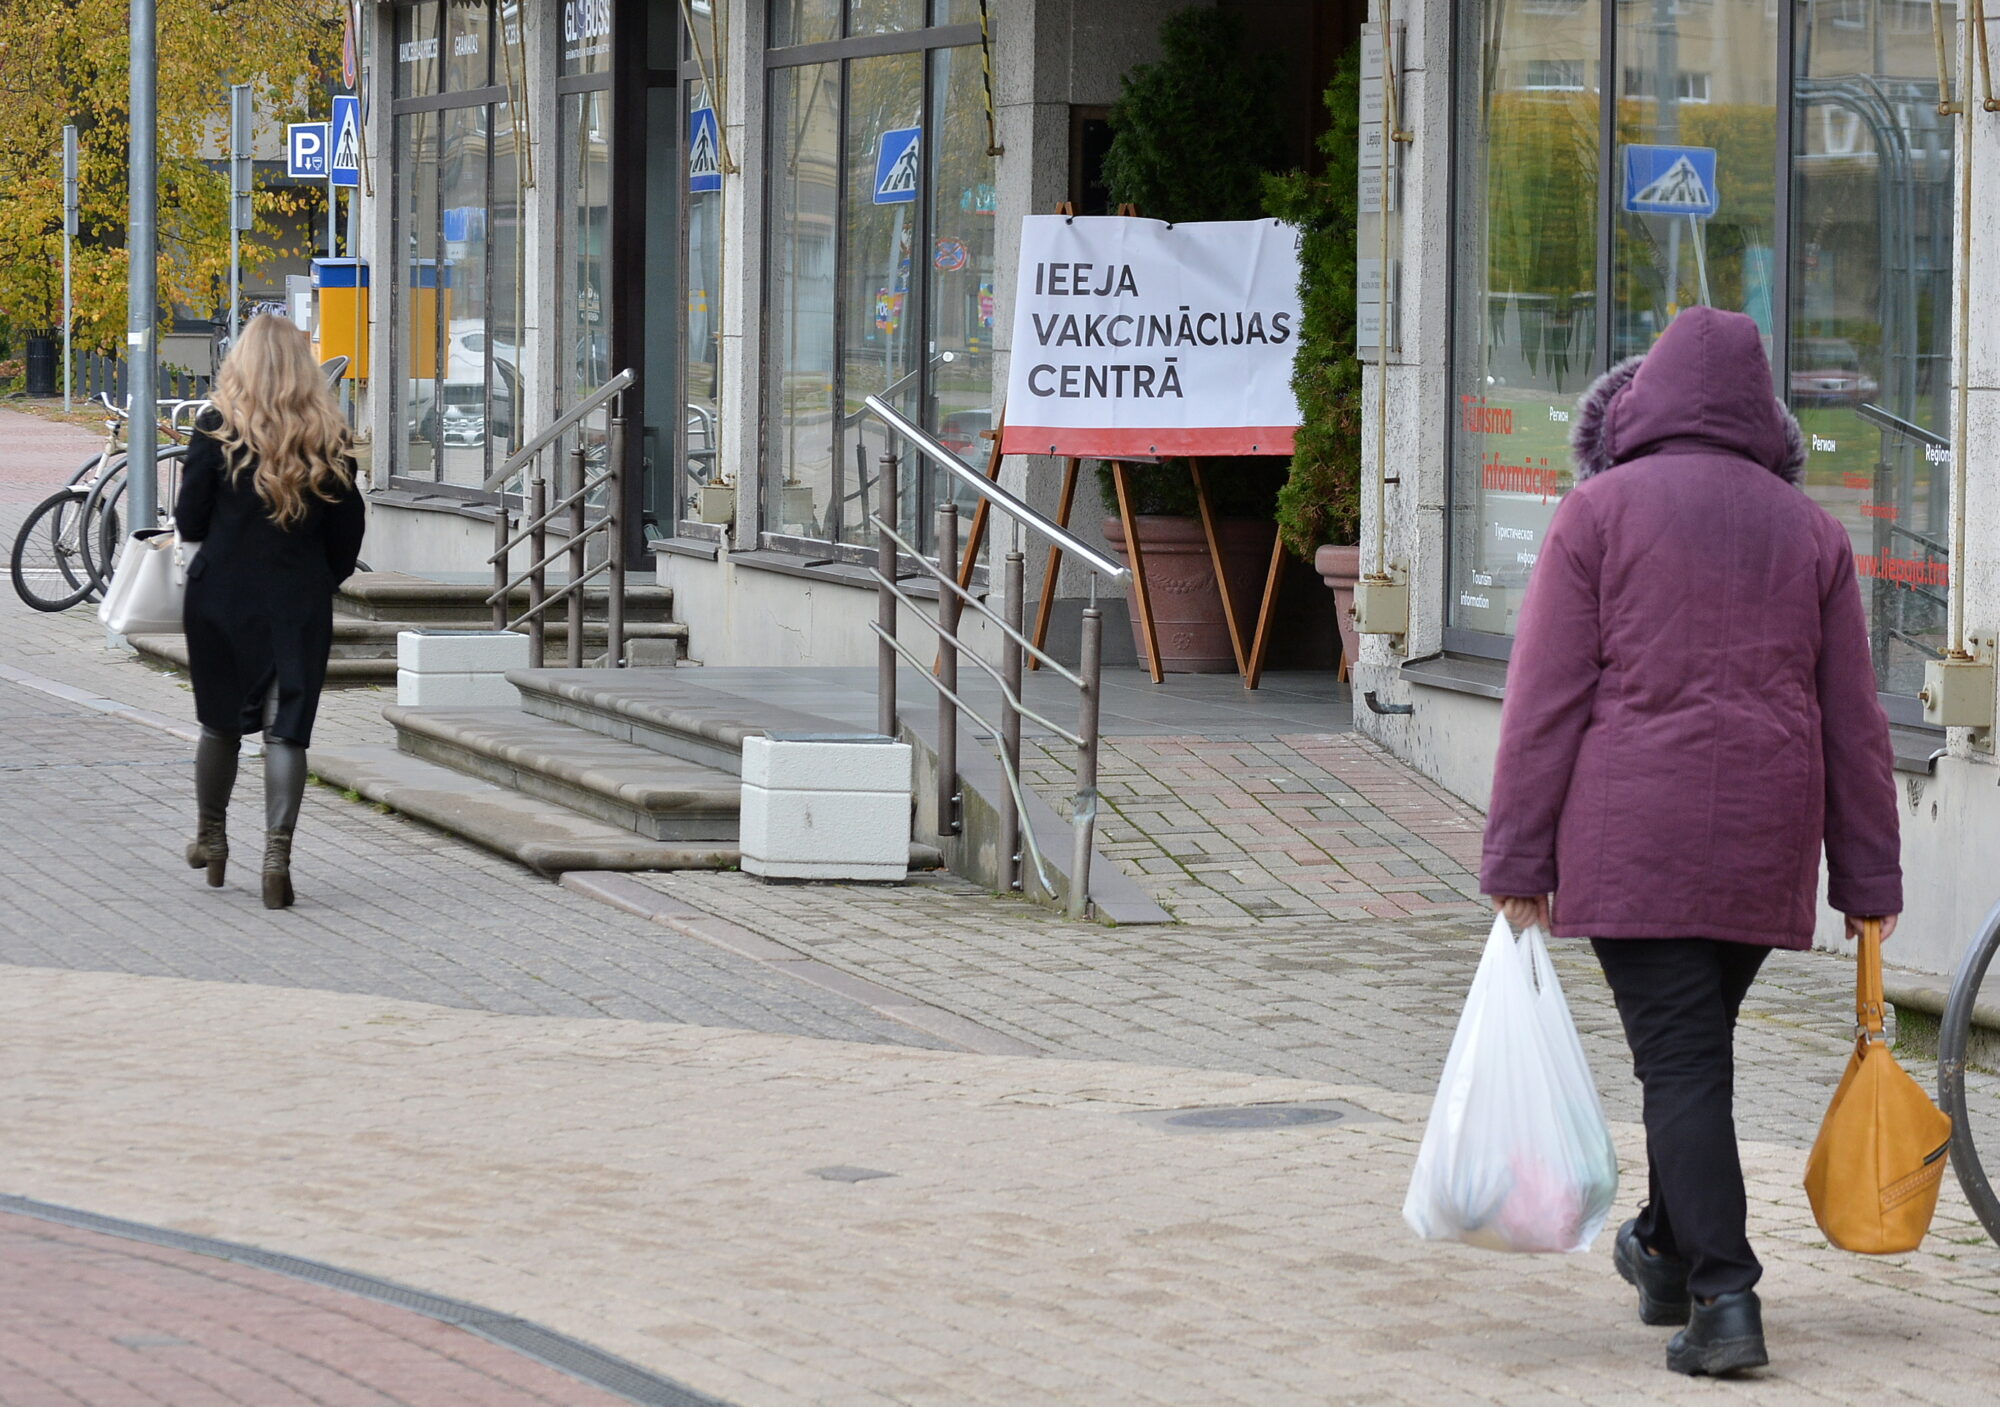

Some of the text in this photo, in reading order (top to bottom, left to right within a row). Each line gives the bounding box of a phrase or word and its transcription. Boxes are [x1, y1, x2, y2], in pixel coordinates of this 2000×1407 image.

[296, 133, 320, 168] P
[1034, 262, 1139, 298] IEEJA
[1032, 305, 1291, 347] VAKCINĀCIJAS
[1028, 357, 1184, 398] CENTRĀ
[1461, 394, 1513, 433] Tūrisma
[1812, 434, 1836, 453] Регион
[1482, 452, 1557, 505] informācija
[1472, 569, 1492, 586] Tourism
[1460, 590, 1489, 609] information
